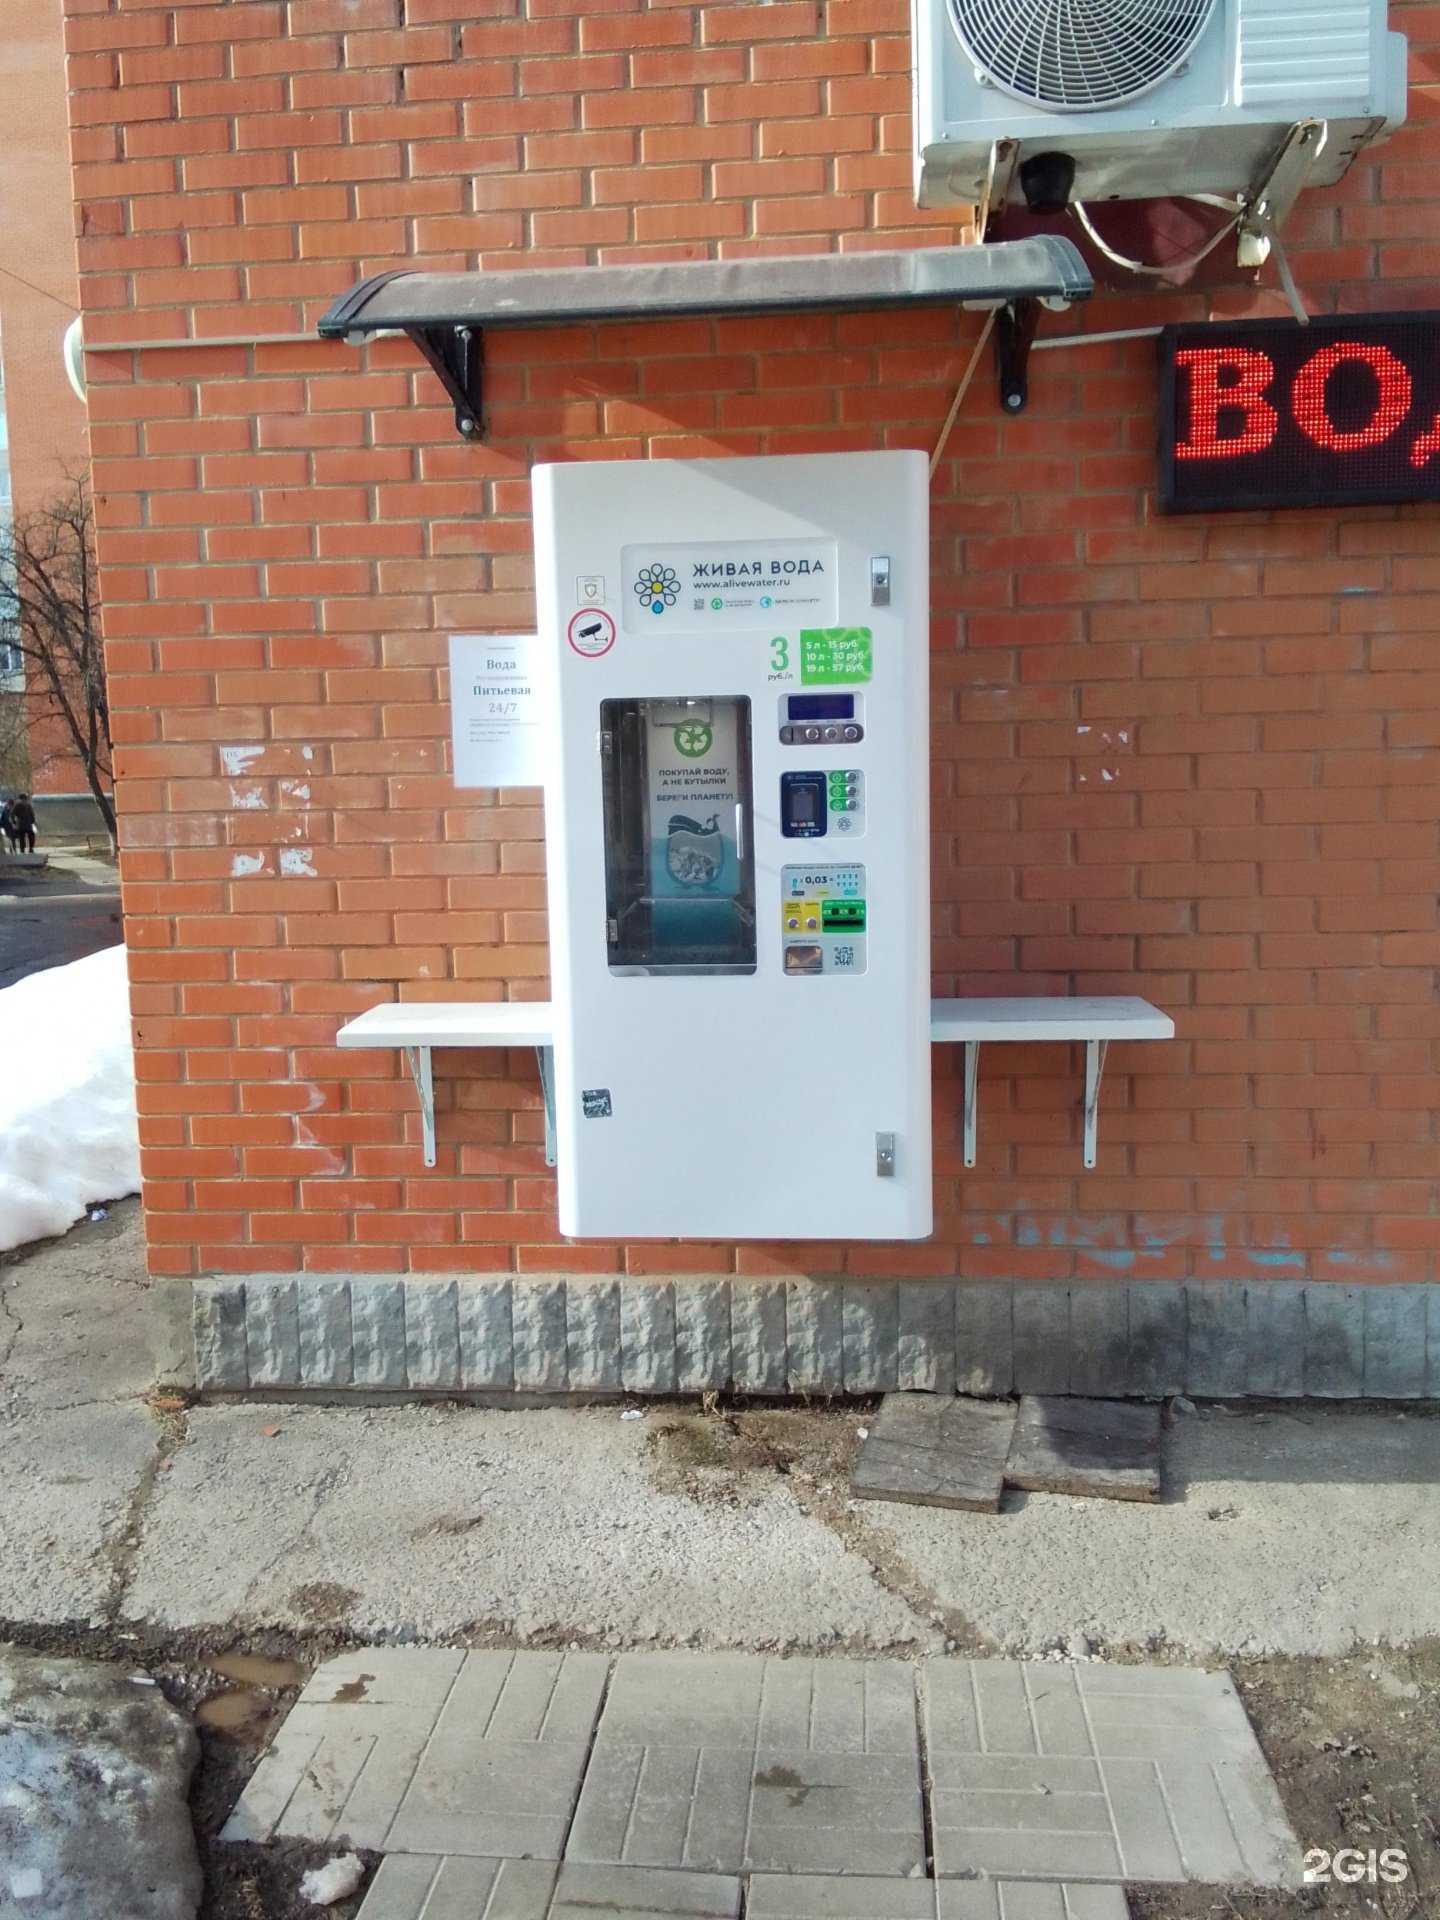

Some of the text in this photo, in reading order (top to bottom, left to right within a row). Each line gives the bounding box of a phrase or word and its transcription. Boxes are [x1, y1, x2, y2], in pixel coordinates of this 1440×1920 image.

[1174, 342, 1440, 467] ВО
[692, 560, 824, 577] ЖИВАЯ ВОДА
[693, 579, 790, 589] www.alivewater.ru
[770, 636, 789, 671] 3
[806, 652, 816, 661] 10
[486, 659, 516, 671] Вода
[472, 685, 531, 696] Питьевая
[488, 702, 517, 715] 24/7
[659, 768, 730, 776] ПОКУПАЙ ВОДУ,
[684, 777, 726, 785] БУТЫЛКИ
[691, 793, 734, 801] ПЛАНЕТУ!
[804, 875, 828, 885] 0,03
